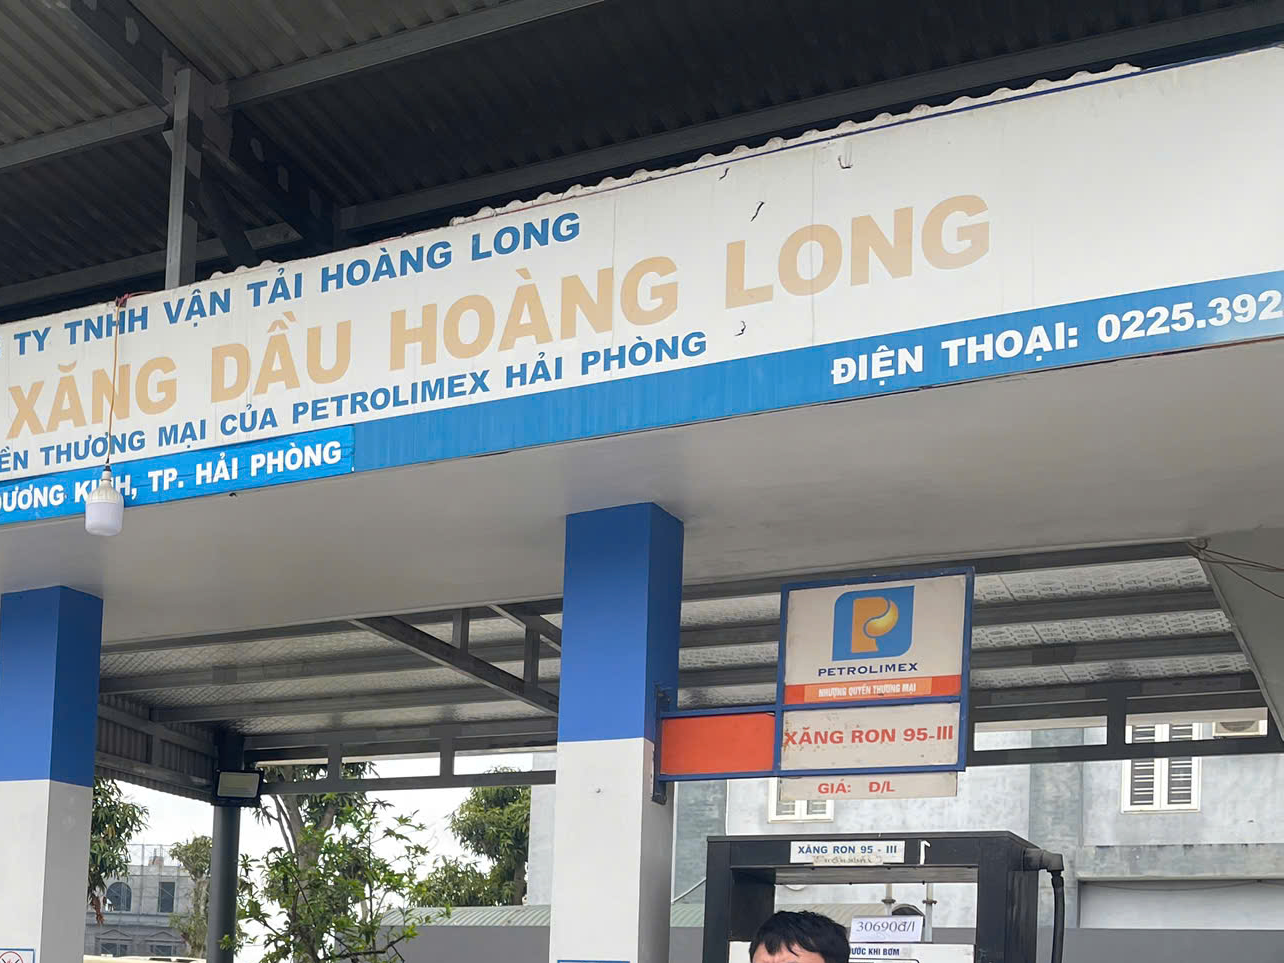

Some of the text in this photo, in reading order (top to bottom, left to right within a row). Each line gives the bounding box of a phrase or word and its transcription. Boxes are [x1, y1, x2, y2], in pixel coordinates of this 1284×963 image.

[15, 327, 52, 355] TY
[65, 305, 148, 345] TNHH
[163, 288, 231, 327] VẬN
[247, 267, 303, 307] TẢI
[321, 241, 452, 292] HOÀNG
[471, 212, 580, 261] LONG
[7, 356, 177, 440] XĂNG
[211, 311, 352, 403] DẦU
[389, 255, 678, 372] HOÀNG
[725, 194, 990, 310] LONG
[831, 290, 1284, 386] ĐIỆN THOẠI: 0225.392
[40, 430, 146, 466] THƯƠNG
[158, 419, 206, 448] MẠI
[220, 403, 278, 435] CỦA
[292, 369, 490, 424] PETROLIMEX
[506, 352, 563, 388] HẢI
[581, 331, 707, 376] PHÒNG
[148, 468, 184, 492] TP.
[195, 452, 238, 486] HẢI
[250, 440, 341, 476] PHÒNG
[818, 662, 918, 676] PETROLIMEX
[784, 726, 844, 745] XĂNG
[851, 728, 896, 744] RON
[833, 845, 856, 854] RON
[860, 845, 873, 854] 95
[851, 947, 866, 956] ƯỚC
[868, 948, 881, 956] KHI
